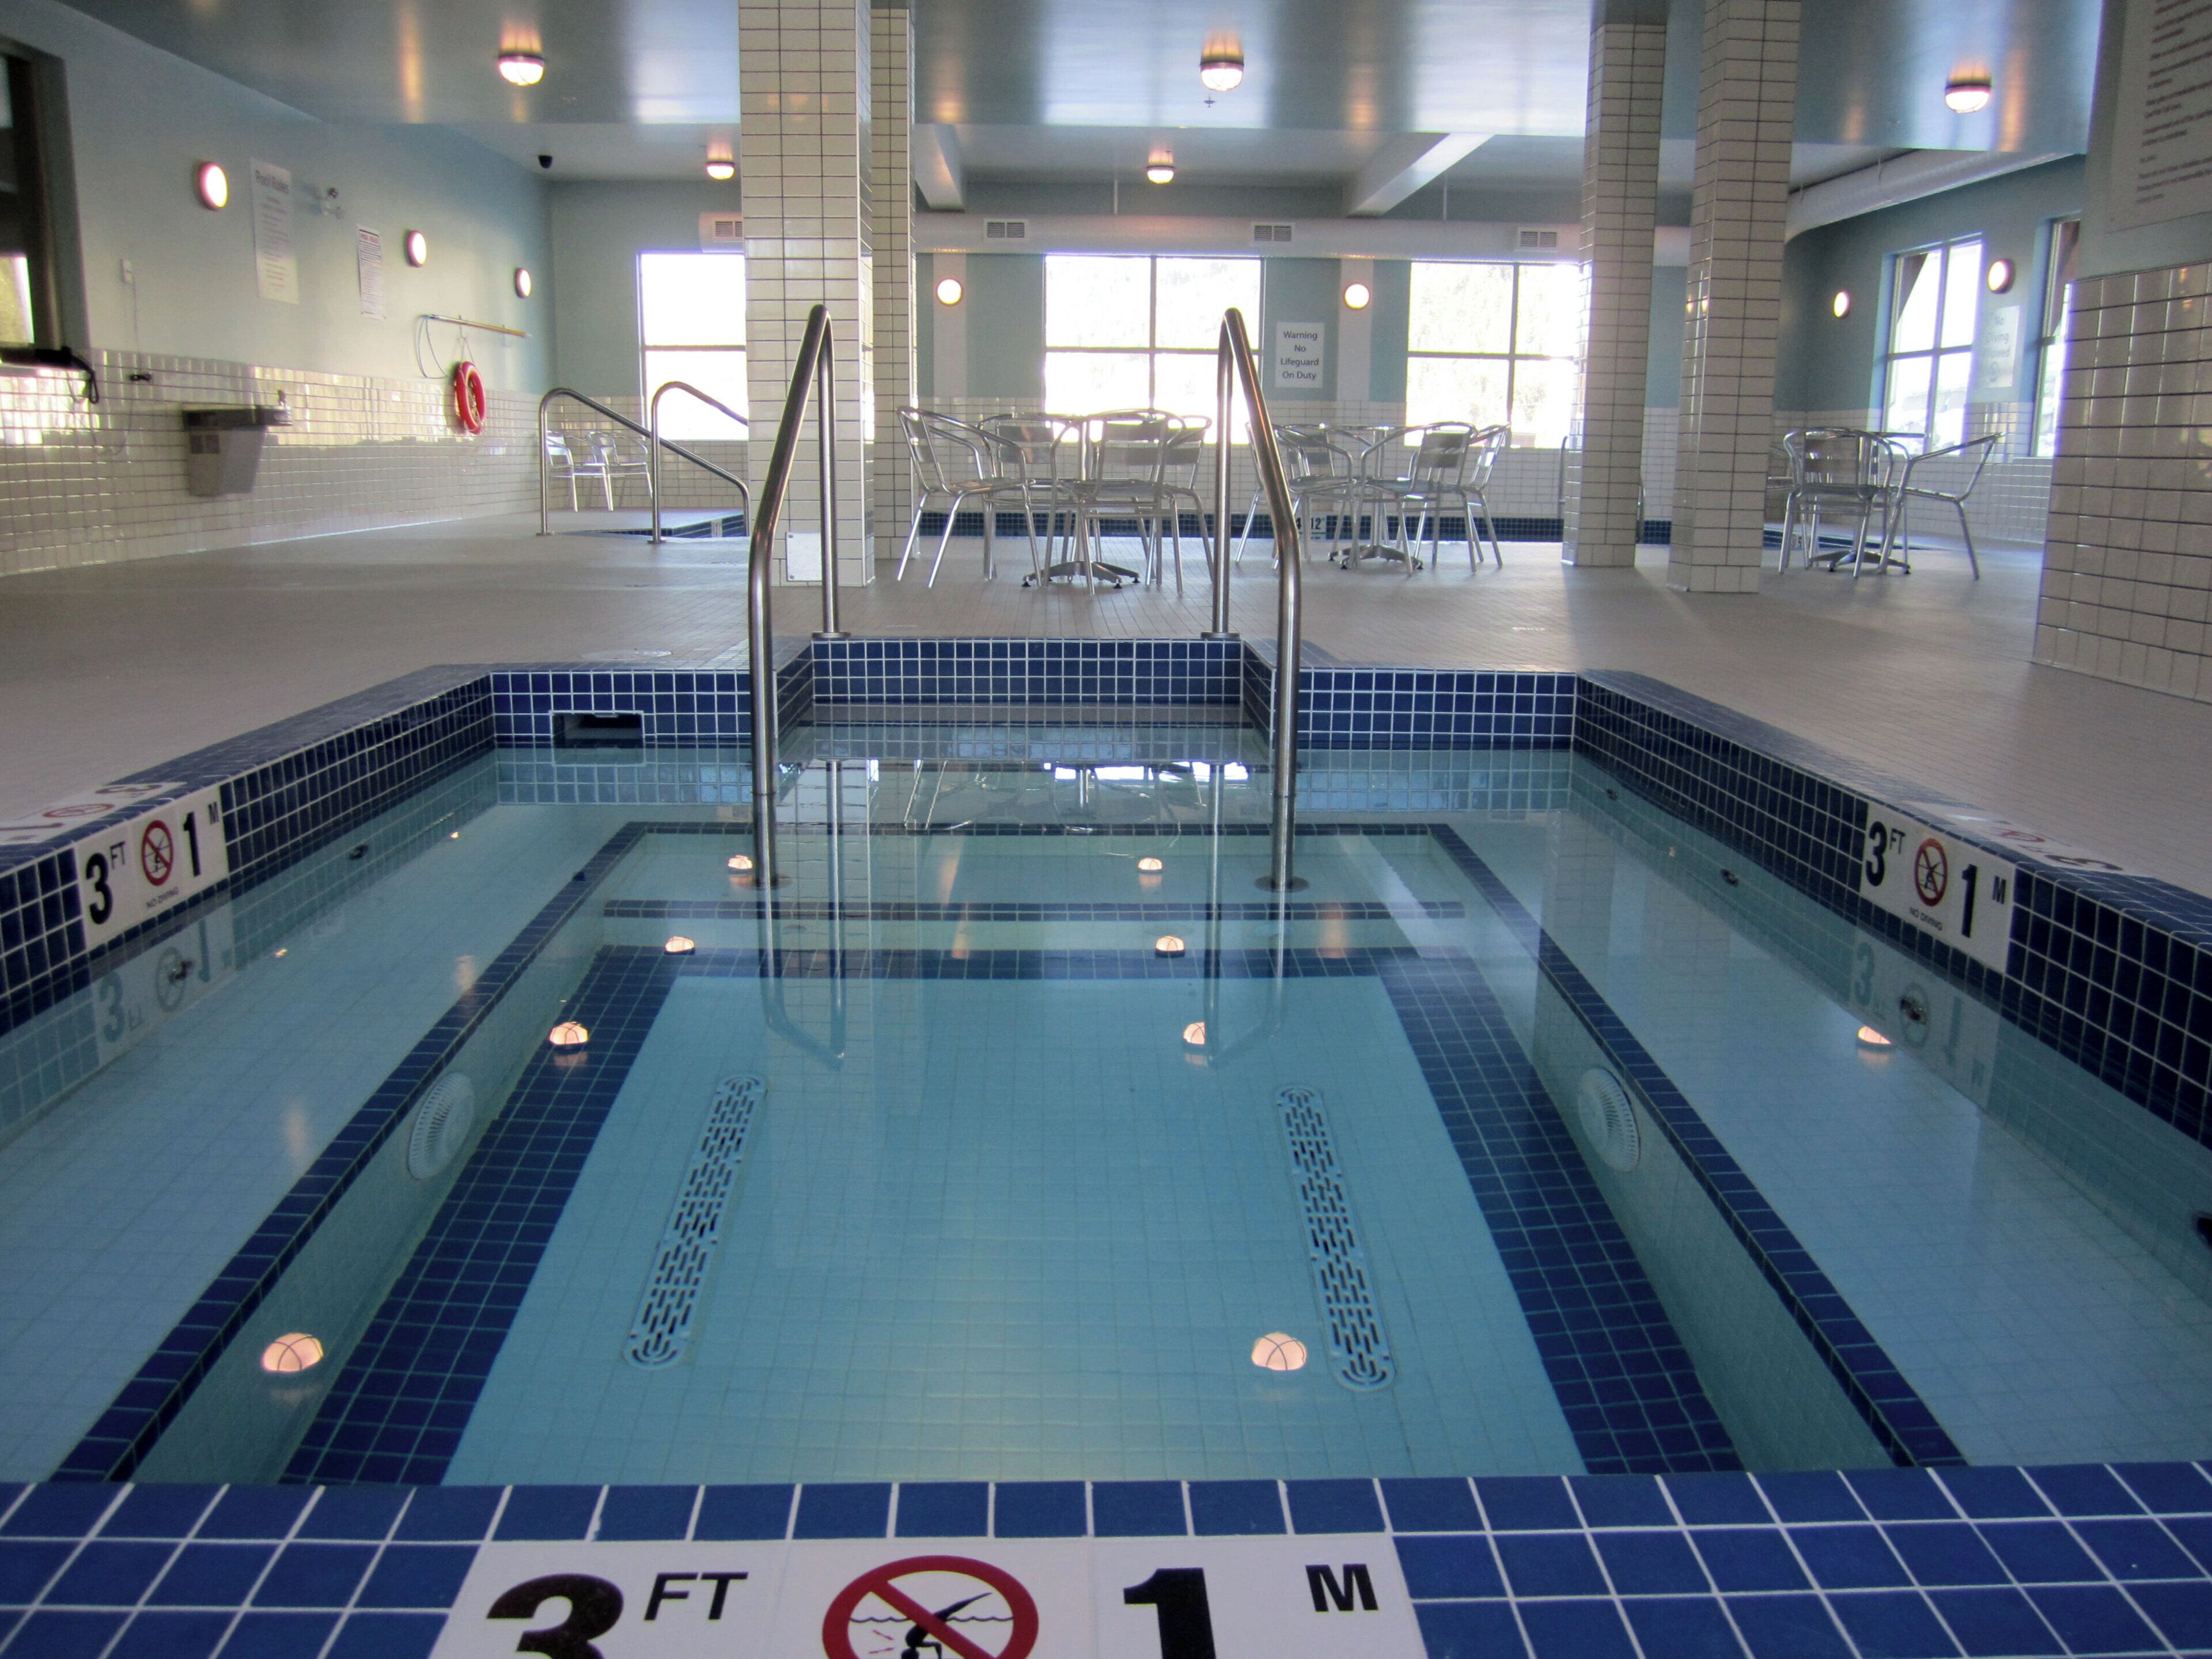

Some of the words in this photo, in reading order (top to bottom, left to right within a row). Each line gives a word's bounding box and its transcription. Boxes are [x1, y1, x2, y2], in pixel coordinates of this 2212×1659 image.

[1283, 331, 1317, 341] Warning
[1281, 358, 1319, 367] Lifeguard
[1297, 371, 1316, 381] Duty
[86, 853, 113, 925] 3
[109, 841, 126, 869] FT
[183, 812, 201, 877] 1
[208, 801, 220, 825] M
[1866, 821, 1887, 887] 3
[1890, 828, 1906, 854] FT
[1961, 864, 1978, 938] 1
[1992, 875, 2006, 904] M
[1910, 906, 1919, 918] NO
[1920, 912, 1943, 931] DIVING
[486, 1573, 624, 1659] 3
[643, 1572, 749, 1620] FT
[1123, 1567, 1216, 1659] 1
[1305, 1564, 1378, 1612] M
